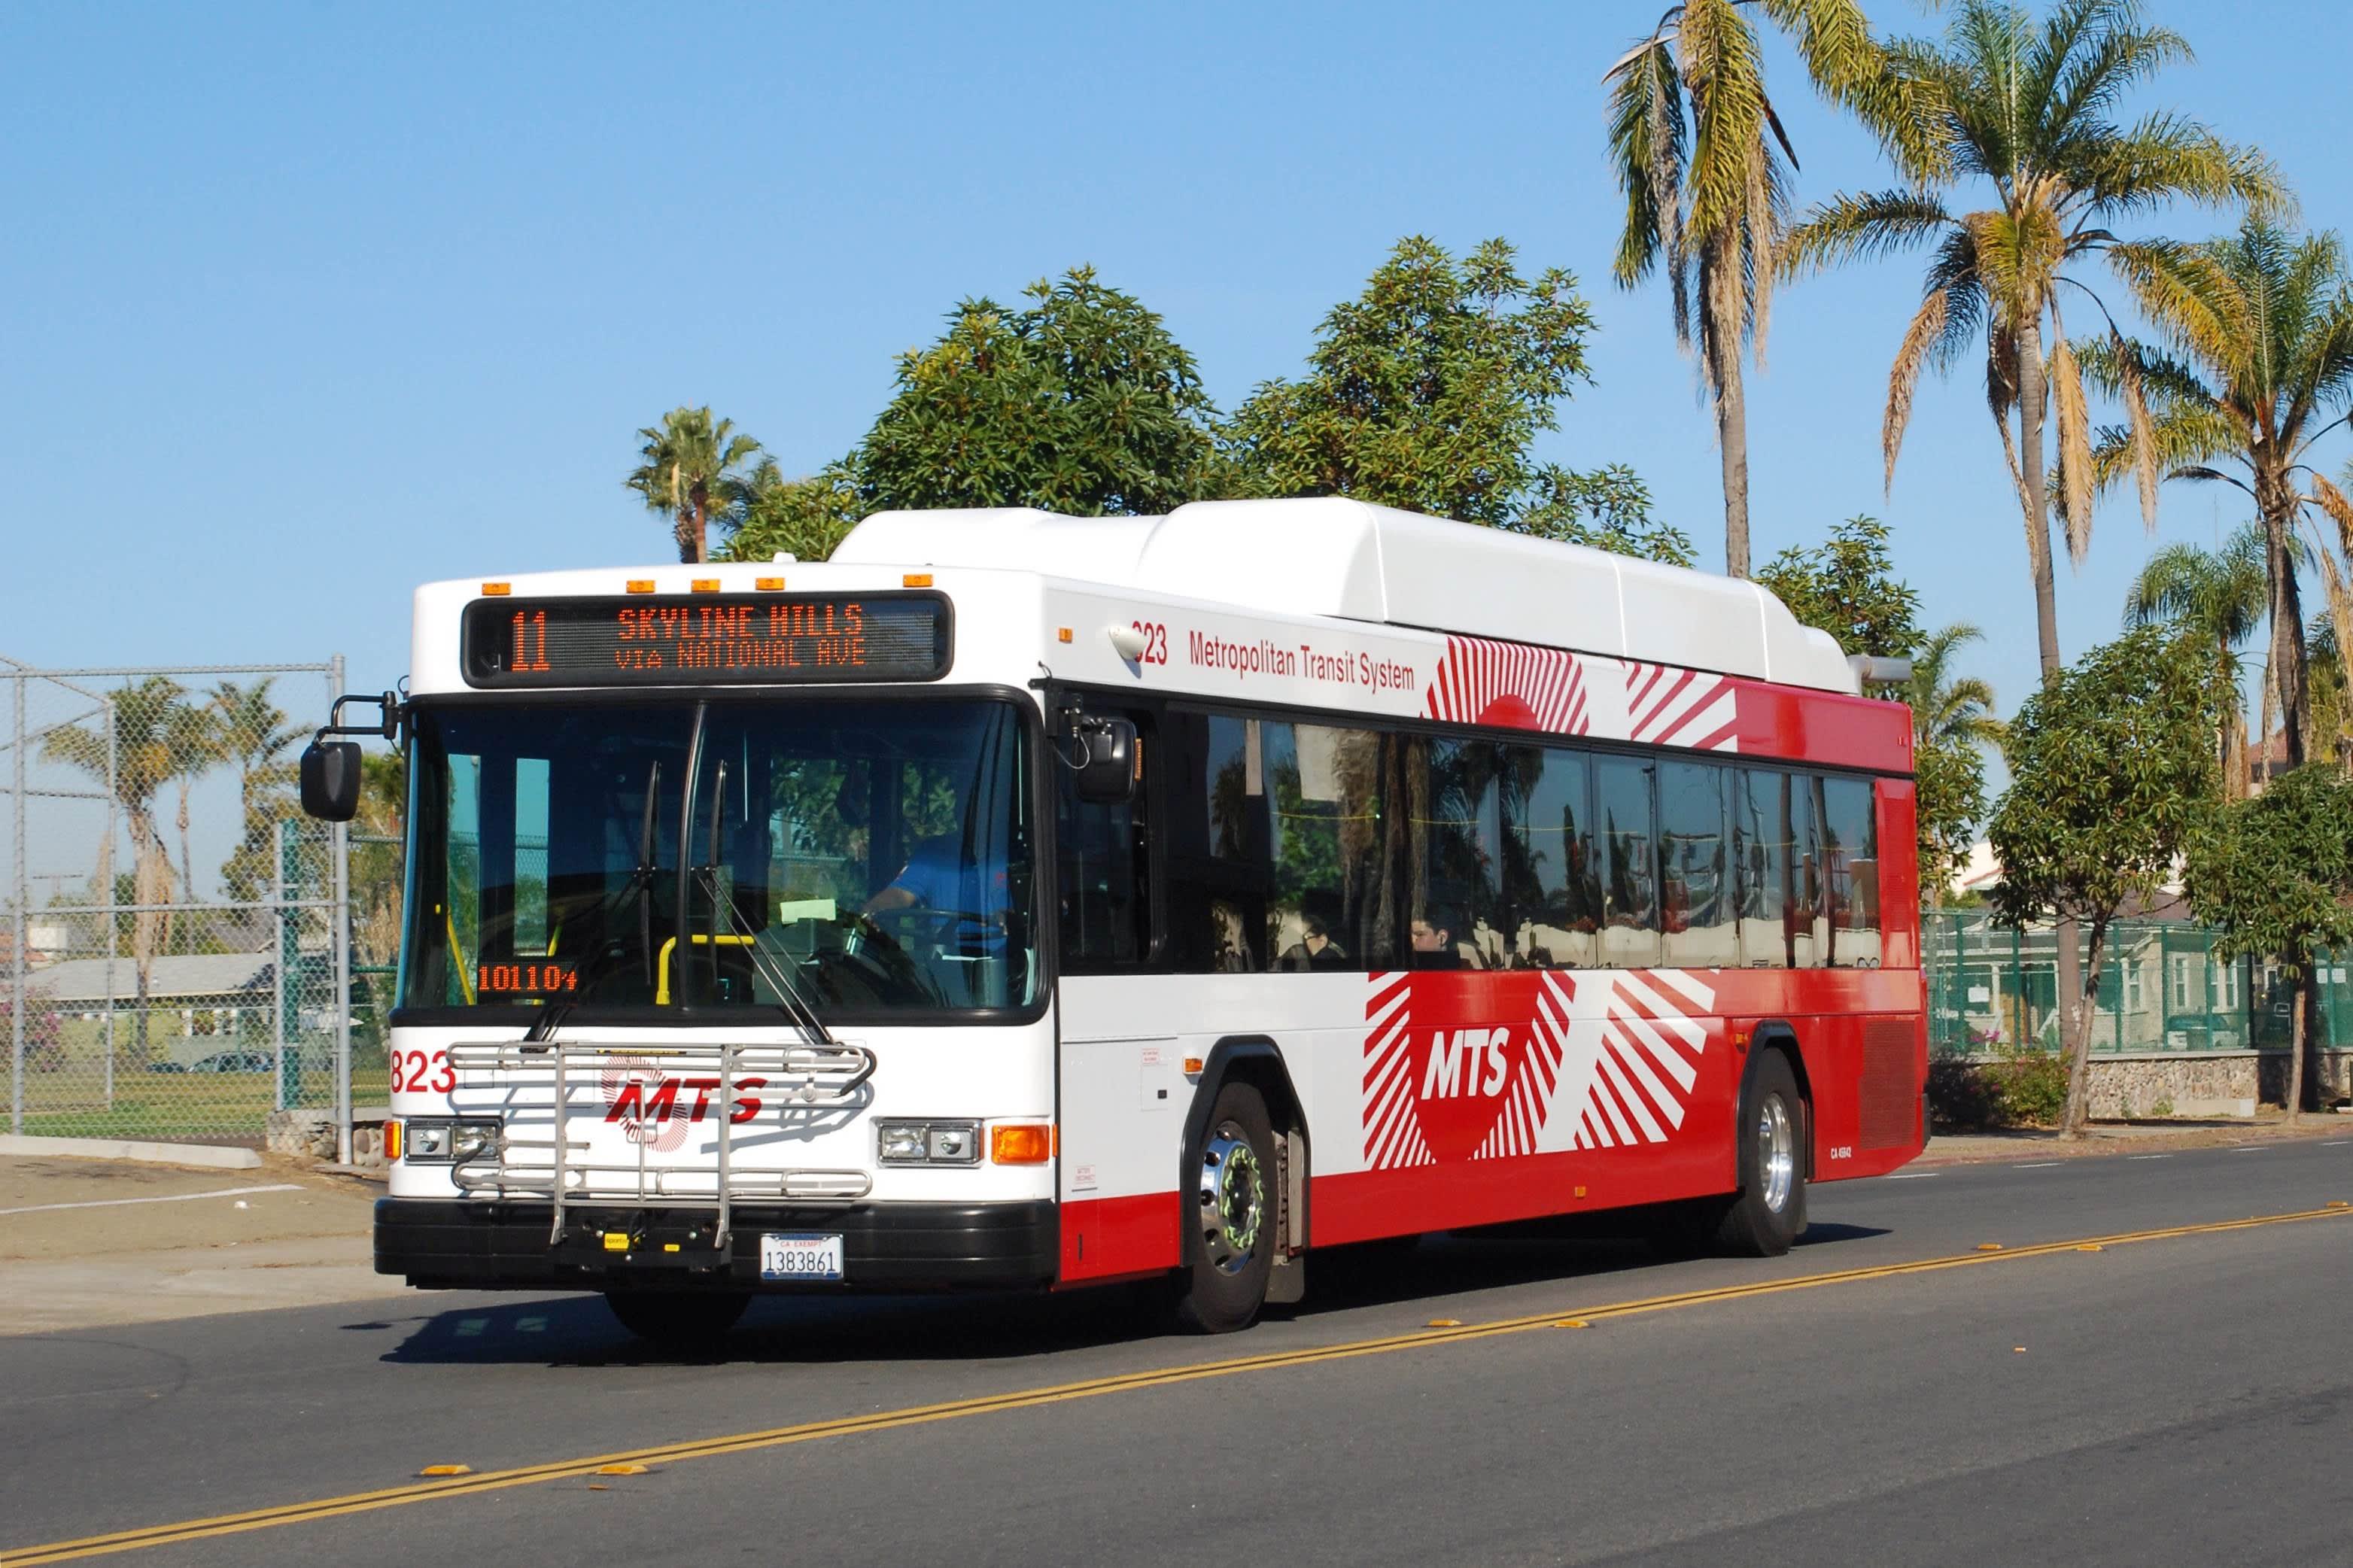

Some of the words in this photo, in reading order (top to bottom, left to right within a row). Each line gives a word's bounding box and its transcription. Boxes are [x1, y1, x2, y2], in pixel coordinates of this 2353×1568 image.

[512, 610, 550, 670] 11
[619, 606, 755, 639] SKYLINE
[770, 604, 862, 637] HILLS
[676, 640, 801, 668] NATIONAL
[818, 637, 865, 666] AVE
[1190, 631, 1295, 679] Metropolitan
[1300, 645, 1355, 683] Transit
[1360, 652, 1414, 694] System
[391, 1050, 456, 1093] 823
[1421, 1027, 1510, 1100] MTS
[604, 1077, 768, 1124] MTS
[766, 1251, 836, 1272] 1383861
